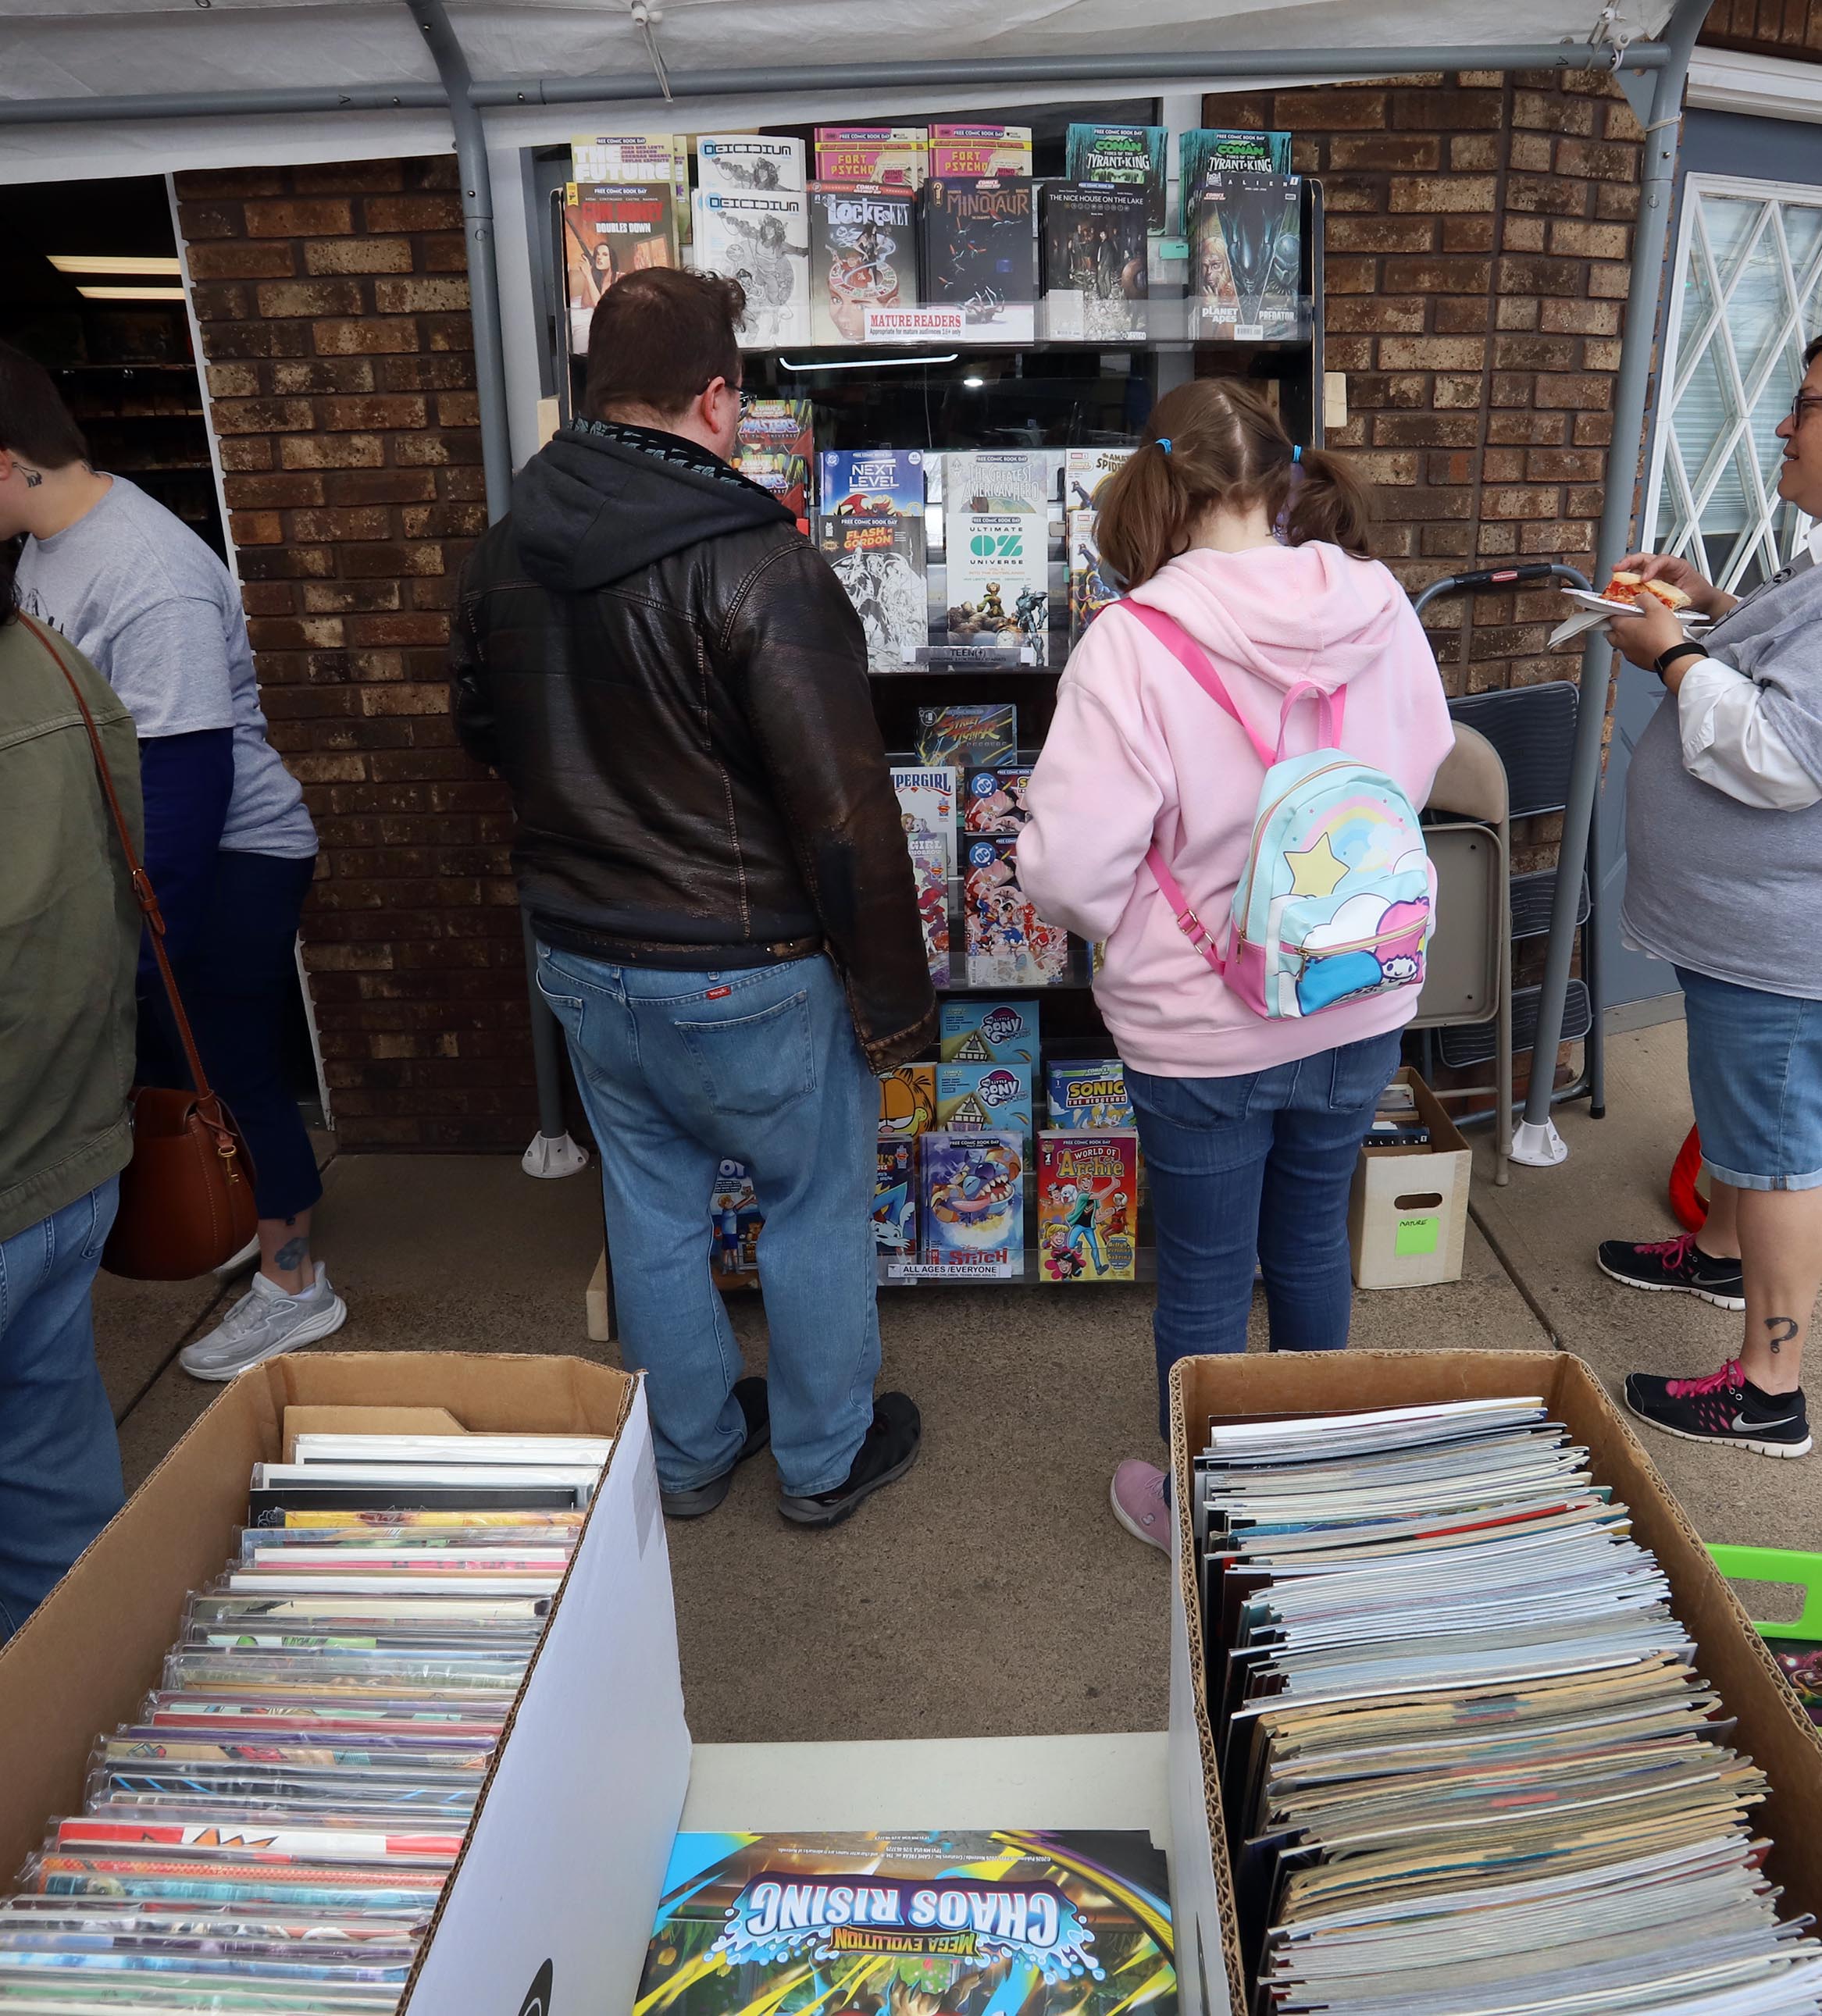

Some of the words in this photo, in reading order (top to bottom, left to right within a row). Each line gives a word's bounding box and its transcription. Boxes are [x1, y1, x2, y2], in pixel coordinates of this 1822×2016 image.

[1095, 139, 1142, 151] CONAN
[1217, 144, 1264, 155] CONAN
[574, 146, 620, 163] THE
[838, 155, 867, 164] FORT
[952, 151, 981, 161] FORT
[575, 162, 672, 181] FUTURE
[831, 166, 875, 175] PSYCHO
[945, 162, 987, 172] PSYCHO
[828, 194, 884, 226] LOCKE
[947, 191, 1029, 217] MINOTAUR
[596, 223, 628, 233] DOUBLES
[628, 223, 651, 233] DOWN
[871, 315, 912, 327] MATURE
[914, 315, 961, 328] READERS
[1259, 311, 1295, 320] PREDATOR
[739, 419, 800, 433] MASTERS
[851, 464, 897, 476] NEXT
[968, 464, 987, 482] THE
[987, 464, 1033, 482] GREATEST
[850, 476, 900, 487] LEVEL
[962, 480, 1012, 504] AMERICAN
[1012, 481, 1039, 501] HERO
[846, 527, 885, 540] FLASH
[843, 536, 891, 548] GORDON
[970, 535, 1023, 557] OZ
[950, 648, 986, 657] TEEN(+)
[893, 773, 951, 792] PERGIRL
[979, 780, 990, 791] DC
[976, 849, 989, 860] DC
[984, 1018, 1020, 1040] PONY
[979, 1081, 1017, 1102] PONY
[1069, 1081, 1125, 1098] SONIC
[1045, 1154, 1051, 1163] 1
[1075, 1148, 1104, 1159] WORLD
[1059, 1149, 1123, 1176] Archie
[746, 1882, 904, 1937] RISING
[911, 1890, 1057, 1948] CHAOS
[833, 1926, 923, 1953] EVOLUTION
[927, 1932, 976, 1956] MEGA
